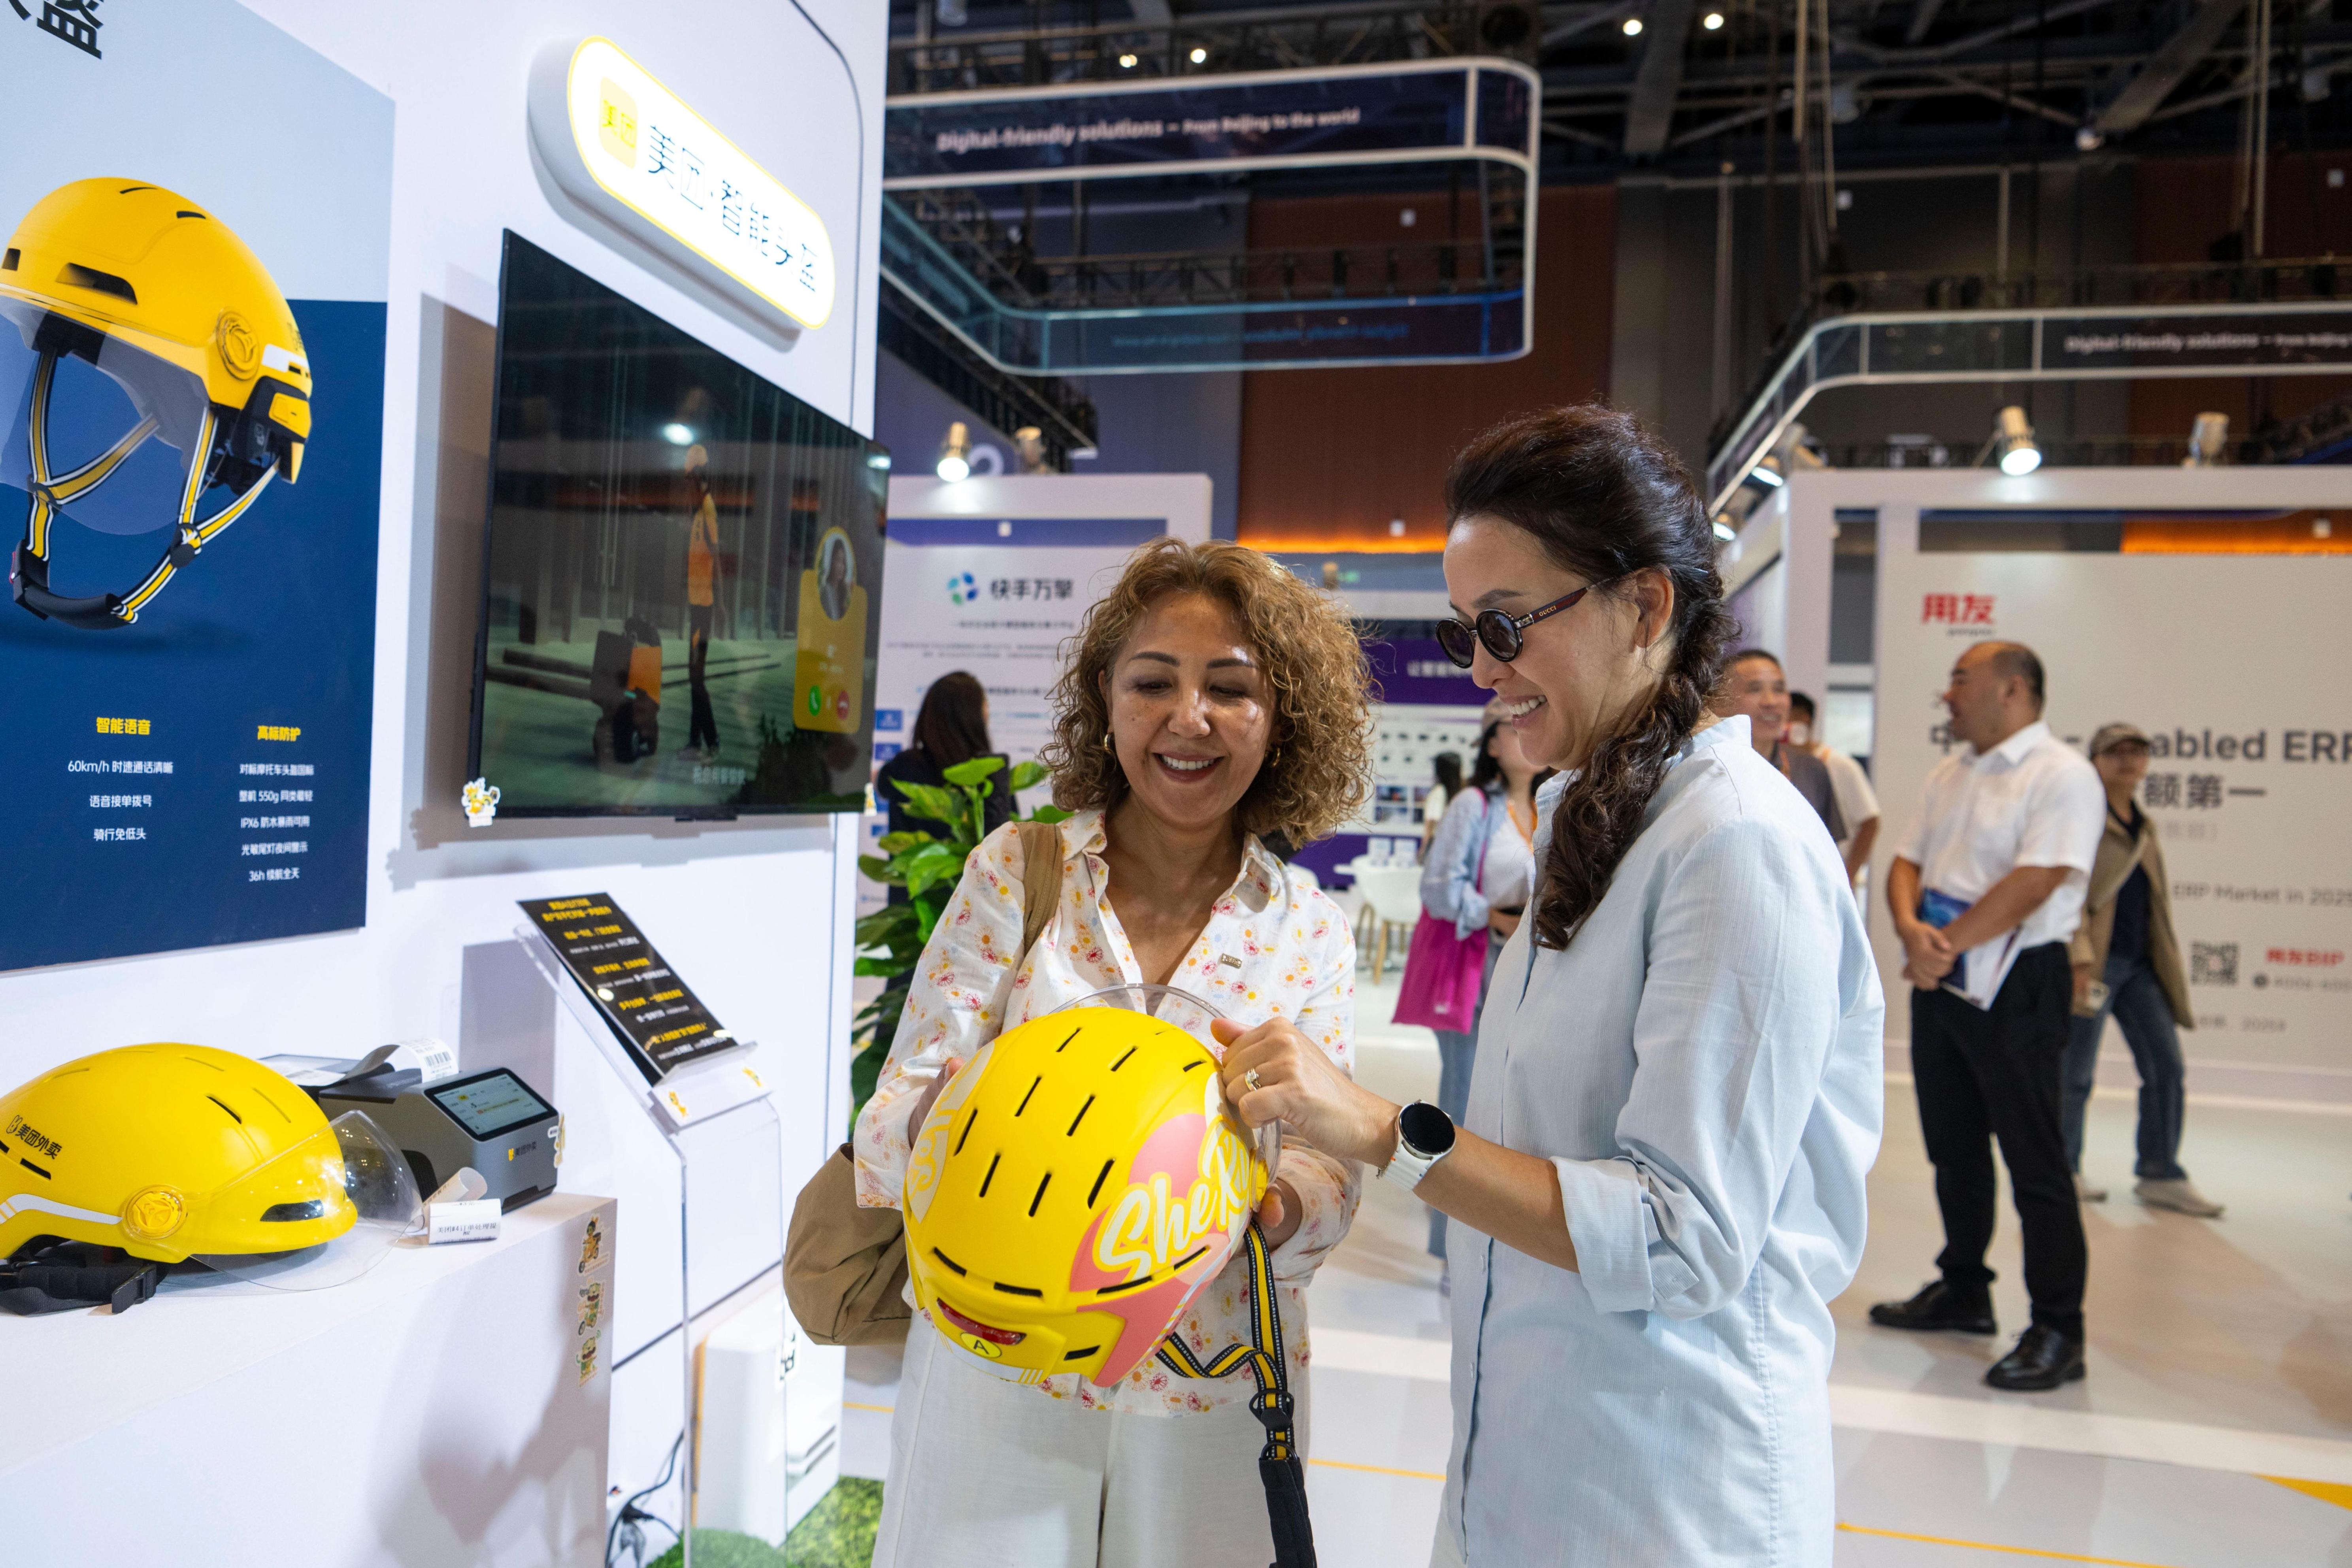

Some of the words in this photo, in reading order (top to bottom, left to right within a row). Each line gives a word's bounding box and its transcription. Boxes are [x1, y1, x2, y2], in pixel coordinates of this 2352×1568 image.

[936, 122, 1076, 155] Digital-friendly
[1079, 119, 1164, 143] solutions
[1316, 106, 1361, 127] world
[1539, 606, 1556, 616] GUCCI
[96, 717, 151, 735] 智能语音
[258, 725, 301, 742] 高标防护
[2148, 729, 2266, 760] abled
[68, 760, 110, 774] 60km/h
[112, 760, 174, 774] 时速通话清晰
[90, 794, 153, 808] 语音接单拨号
[258, 790, 280, 804] 550g
[241, 817, 260, 828] IPX6
[94, 827, 147, 842] 骑行免低头
[249, 870, 266, 882] 36h
[15, 1124, 62, 1160] 美团外卖
[973, 1340, 989, 1355] A
